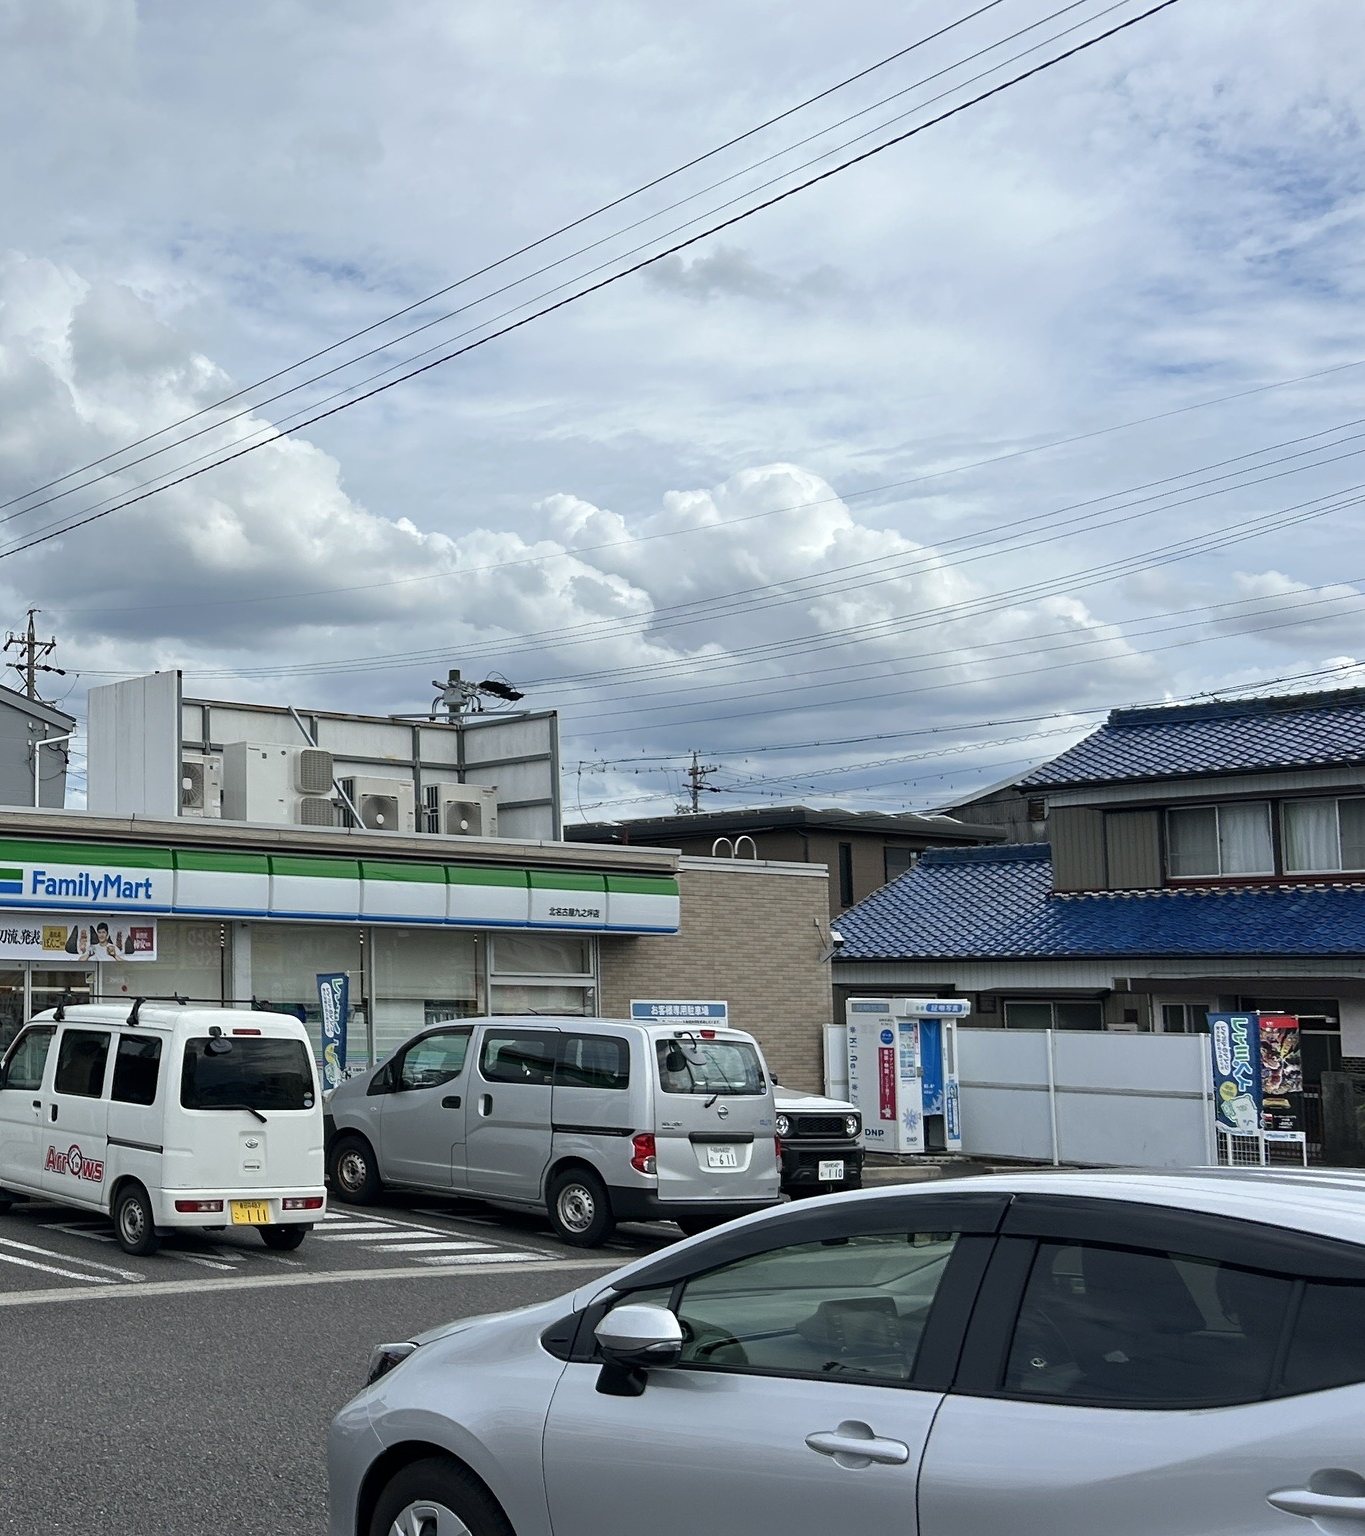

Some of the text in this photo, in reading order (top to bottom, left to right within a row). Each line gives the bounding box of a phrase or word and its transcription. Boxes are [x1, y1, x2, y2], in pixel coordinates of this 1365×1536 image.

[32, 870, 153, 901] FamilyMart
[650, 1004, 709, 1016] お客様専用駐車場
[864, 1128, 884, 1137] DNP
[719, 1154, 735, 1165] 611
